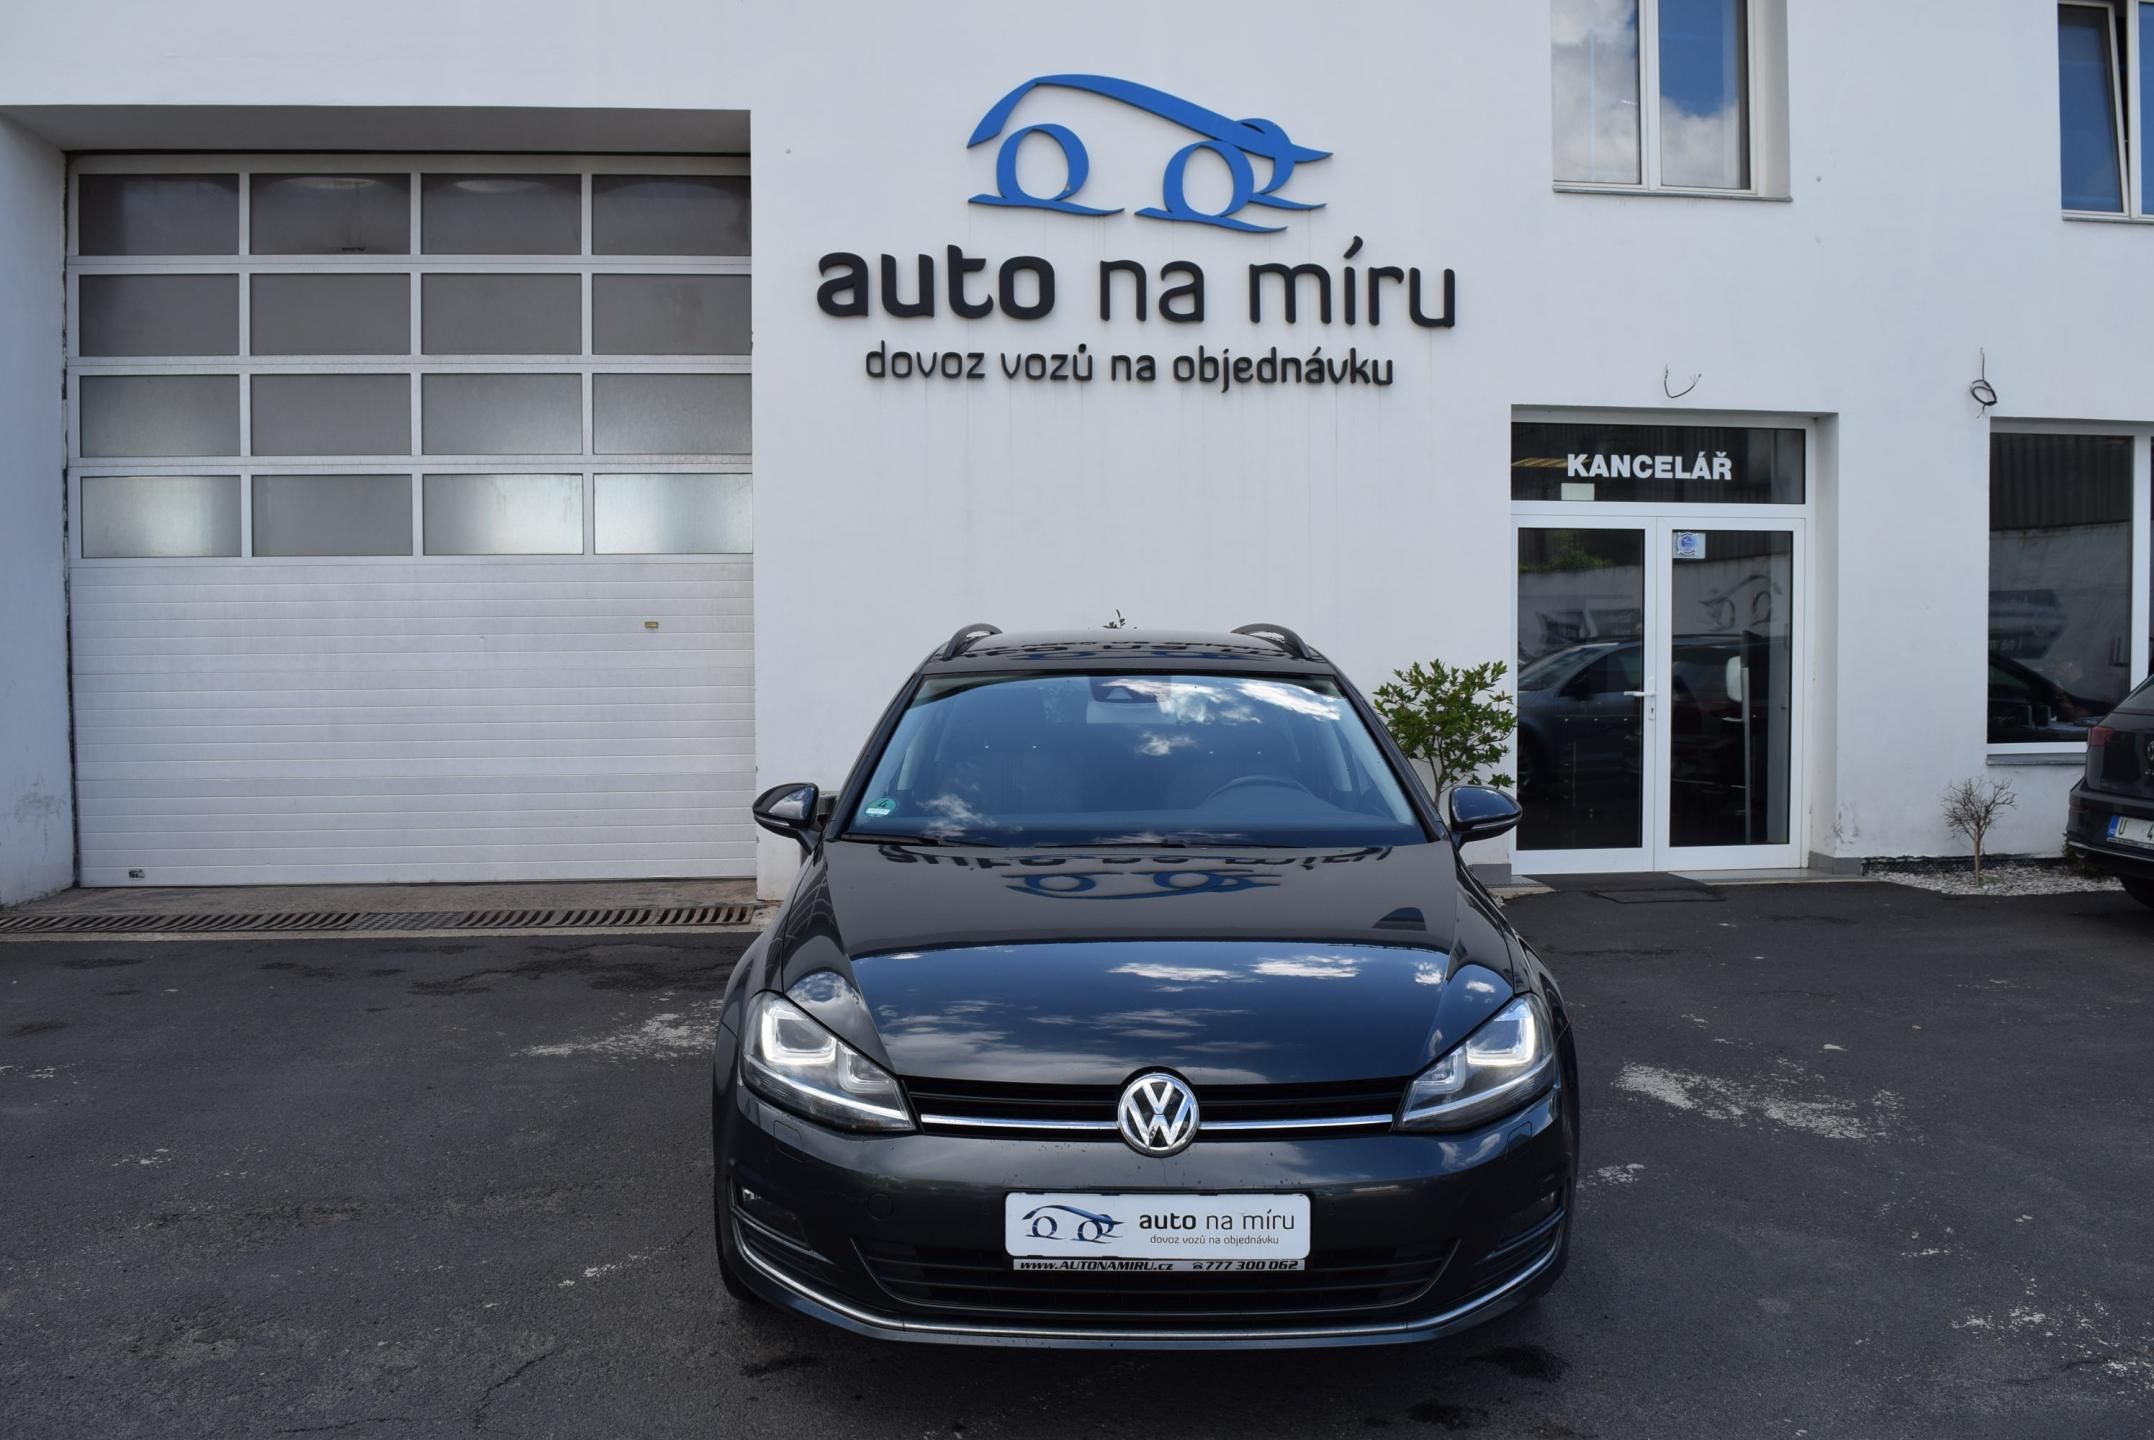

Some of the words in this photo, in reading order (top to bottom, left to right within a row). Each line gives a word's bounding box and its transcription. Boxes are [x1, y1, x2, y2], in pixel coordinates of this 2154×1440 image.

[816, 244, 1056, 321] auto
[1099, 259, 1204, 324] na
[1248, 235, 1456, 329] míru
[865, 340, 985, 380] dovoz
[1000, 343, 1093, 383] vozů
[1110, 352, 1156, 384] na
[1172, 345, 1393, 393] objednávku
[1567, 451, 1732, 480] KANCELÁŘ
[1139, 1212, 1197, 1230] auto
[1206, 1214, 1233, 1231] na
[1243, 1209, 1295, 1231] míru
[1150, 1234, 1180, 1245] dovoz
[1182, 1234, 1206, 1245] vozů
[1209, 1236, 1221, 1245] na
[1223, 1234, 1279, 1246] objednávku
[1020, 1260, 1174, 1271] www.AUTONAMIRU.cz
[1236, 1261, 1266, 1271] 300
[1268, 1261, 1299, 1270] 062
